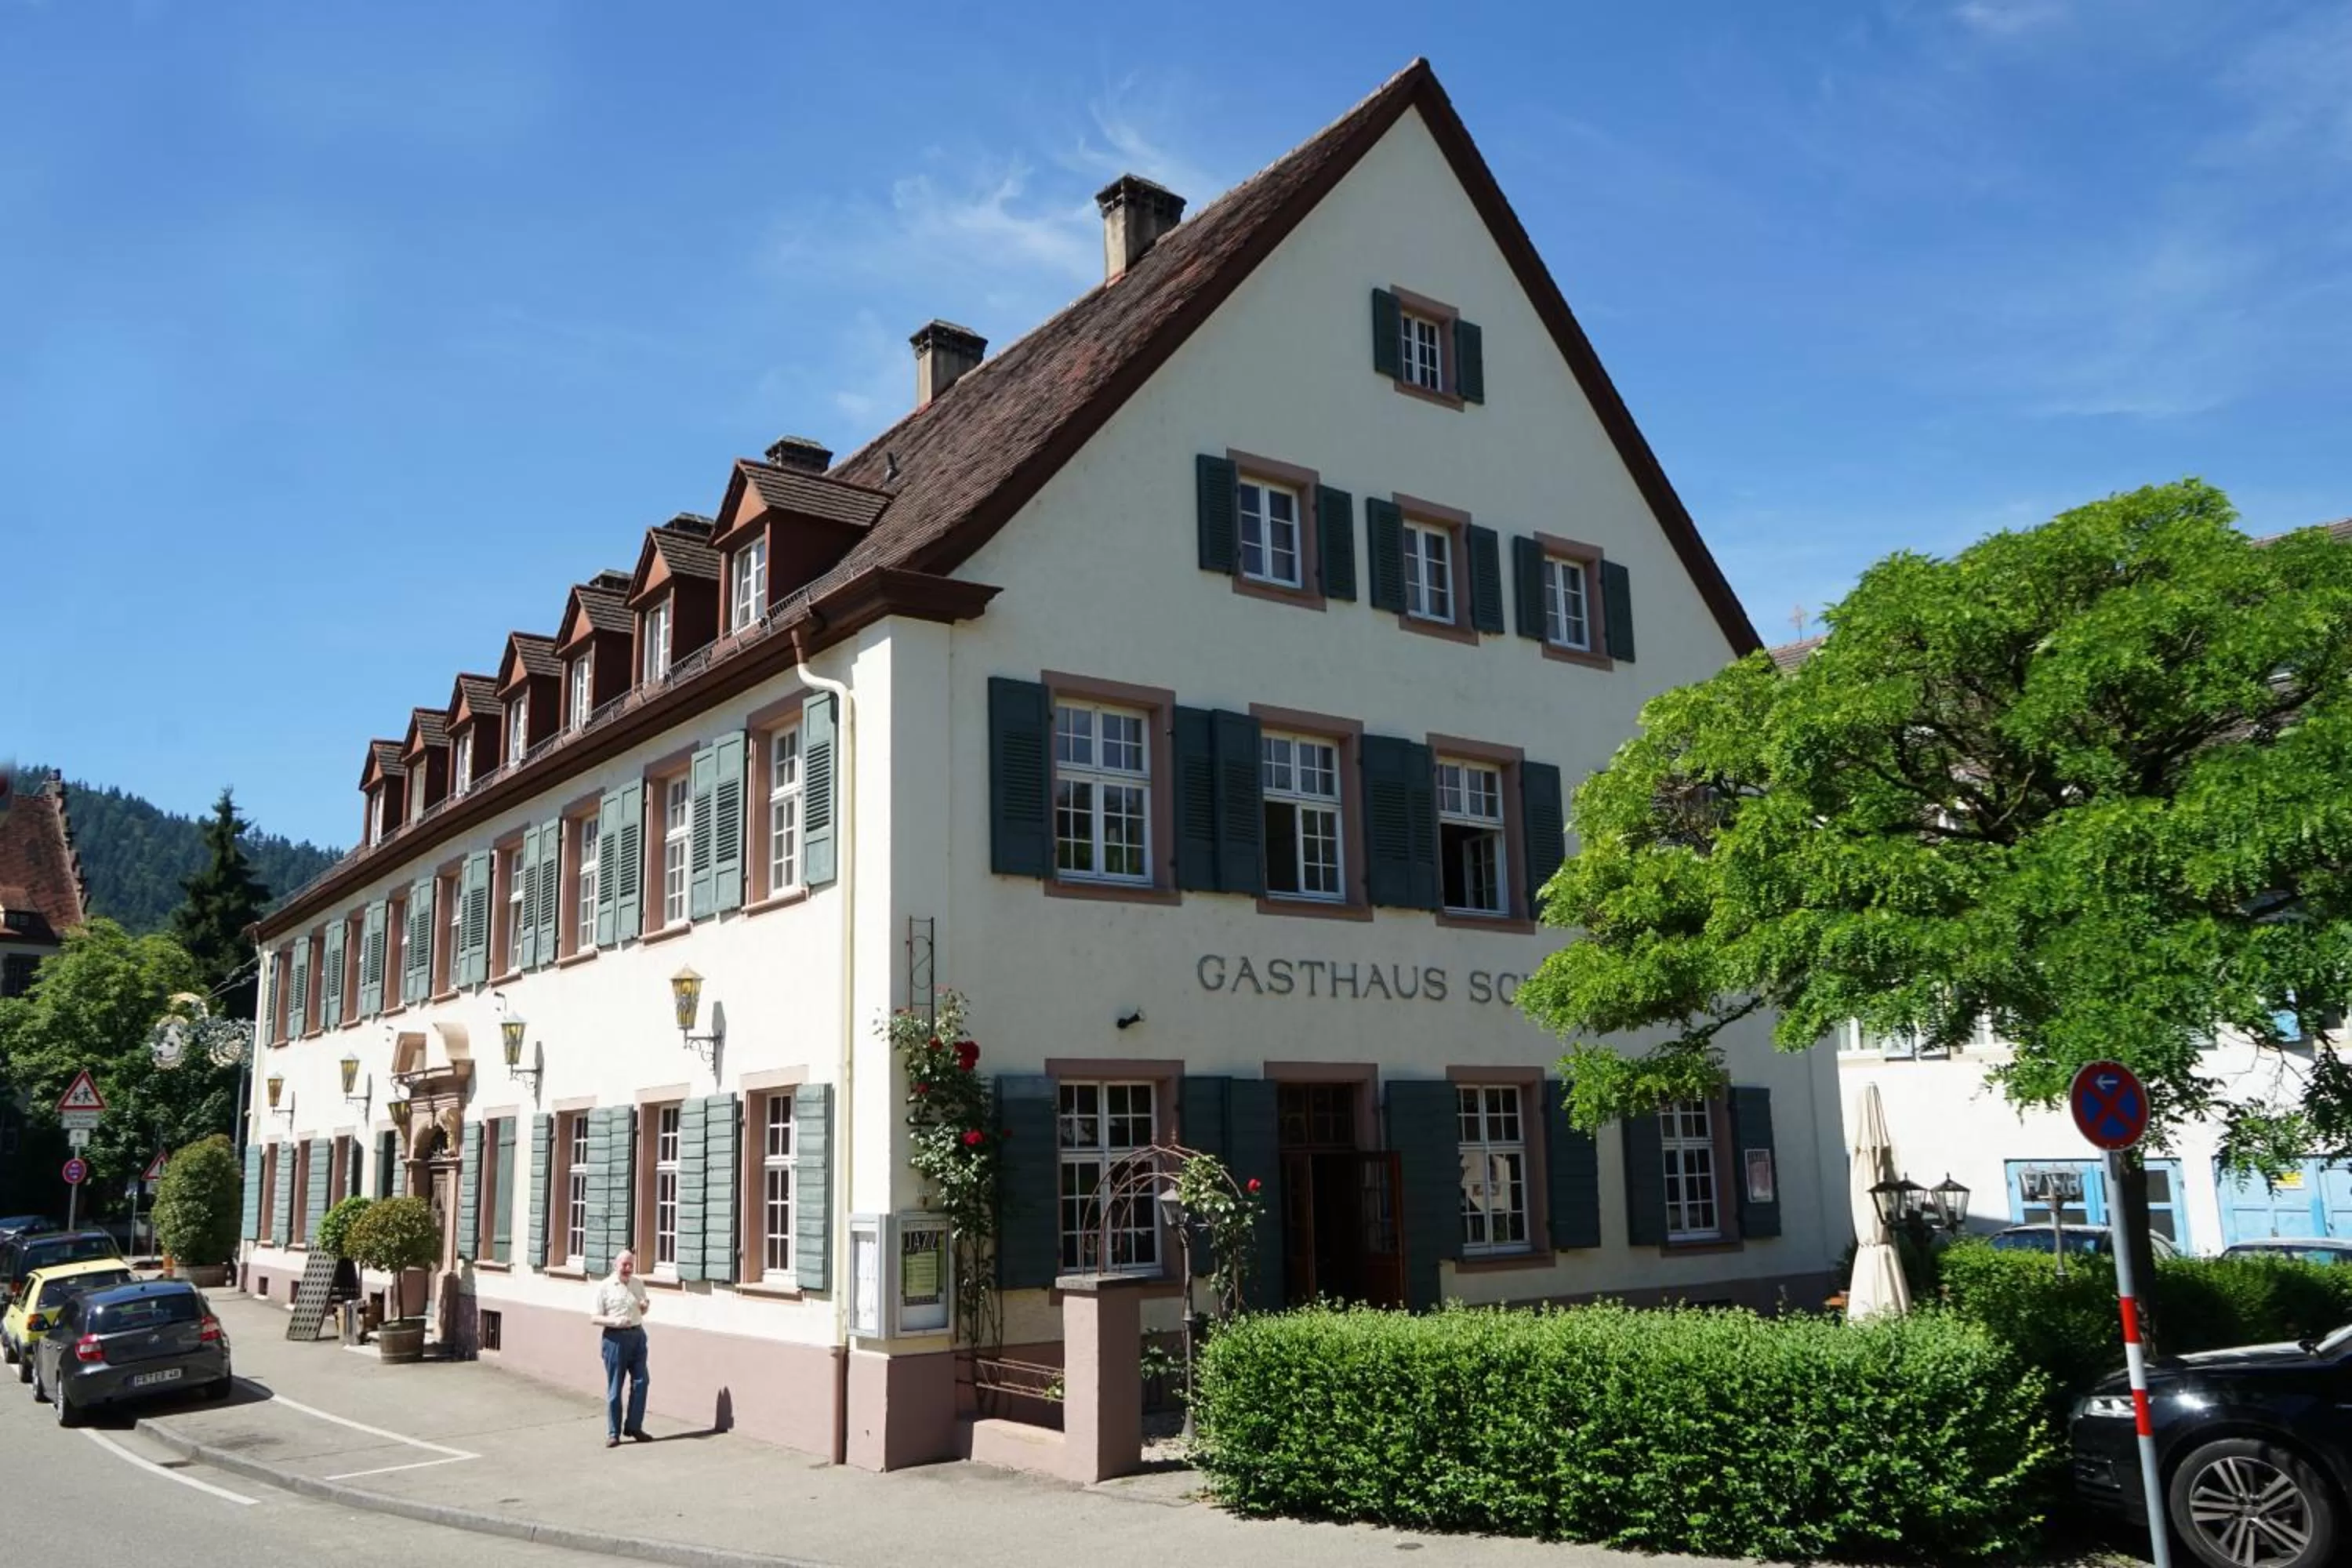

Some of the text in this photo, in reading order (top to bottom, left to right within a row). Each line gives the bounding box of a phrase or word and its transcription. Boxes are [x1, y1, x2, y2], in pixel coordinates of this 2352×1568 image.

[1197, 954, 1530, 1005] GASTHAUS SC
[906, 1231, 937, 1252] JAZZ
